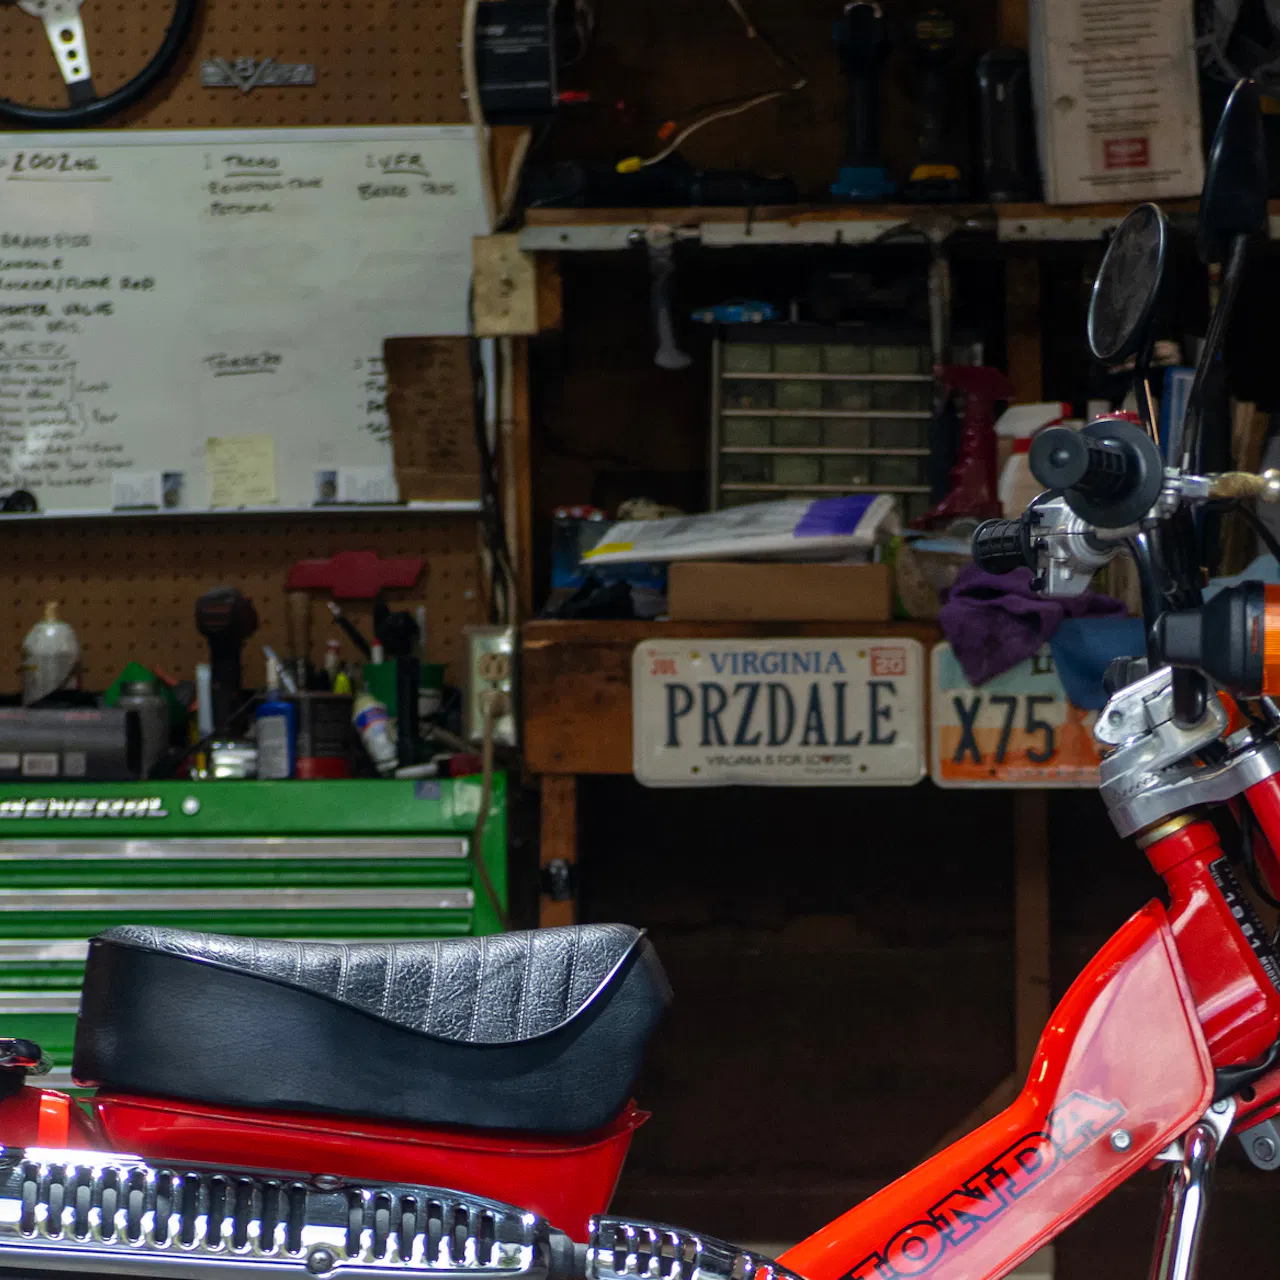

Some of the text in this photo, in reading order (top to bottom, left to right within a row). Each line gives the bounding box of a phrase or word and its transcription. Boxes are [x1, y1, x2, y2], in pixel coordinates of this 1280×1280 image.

[709, 650, 846, 677] VIRGINIA
[664, 680, 898, 748] PRZDALE
[952, 693, 1056, 764] X75
[706, 754, 762, 767] VIRGINIA
[777, 754, 802, 767] FOR
